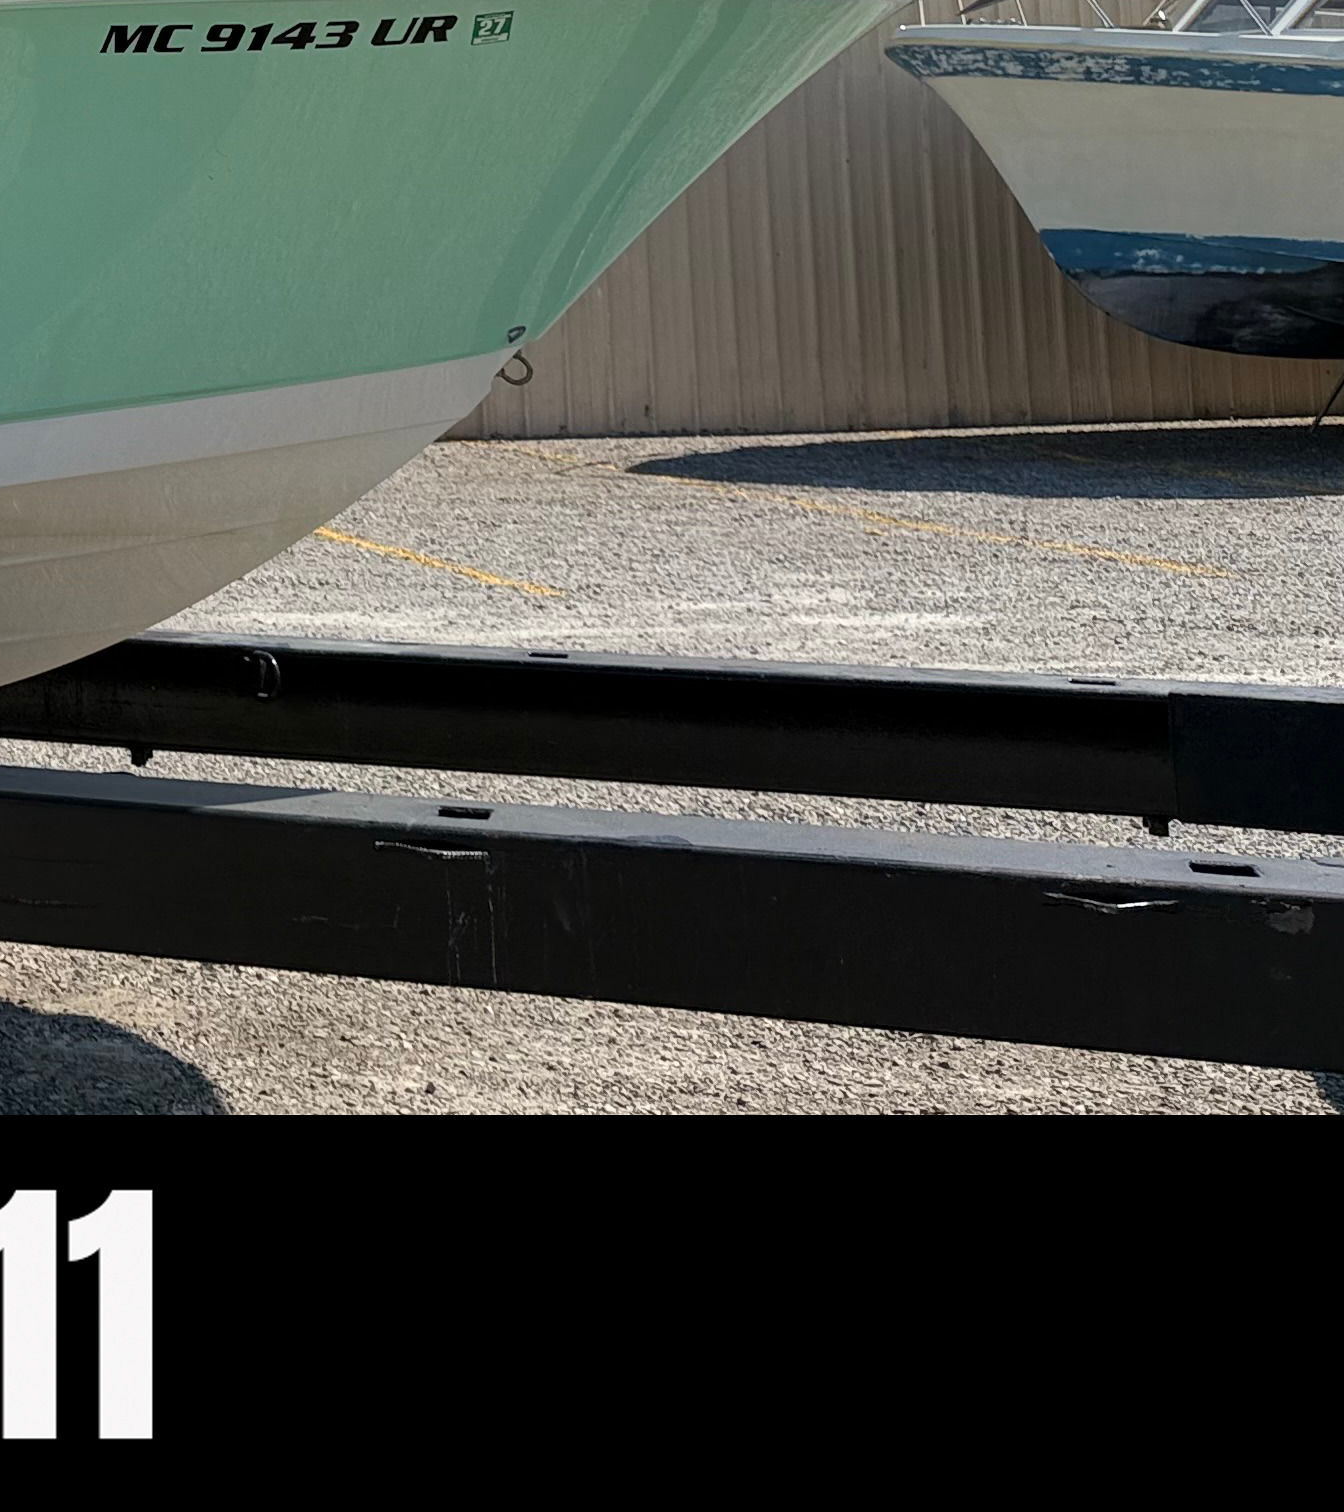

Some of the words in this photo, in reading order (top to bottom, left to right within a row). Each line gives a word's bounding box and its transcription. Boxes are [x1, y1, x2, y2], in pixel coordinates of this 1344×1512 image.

[100, 25, 193, 54] MC
[201, 19, 360, 53] 9143
[370, 15, 459, 47] UR
[478, 18, 506, 36] 27
